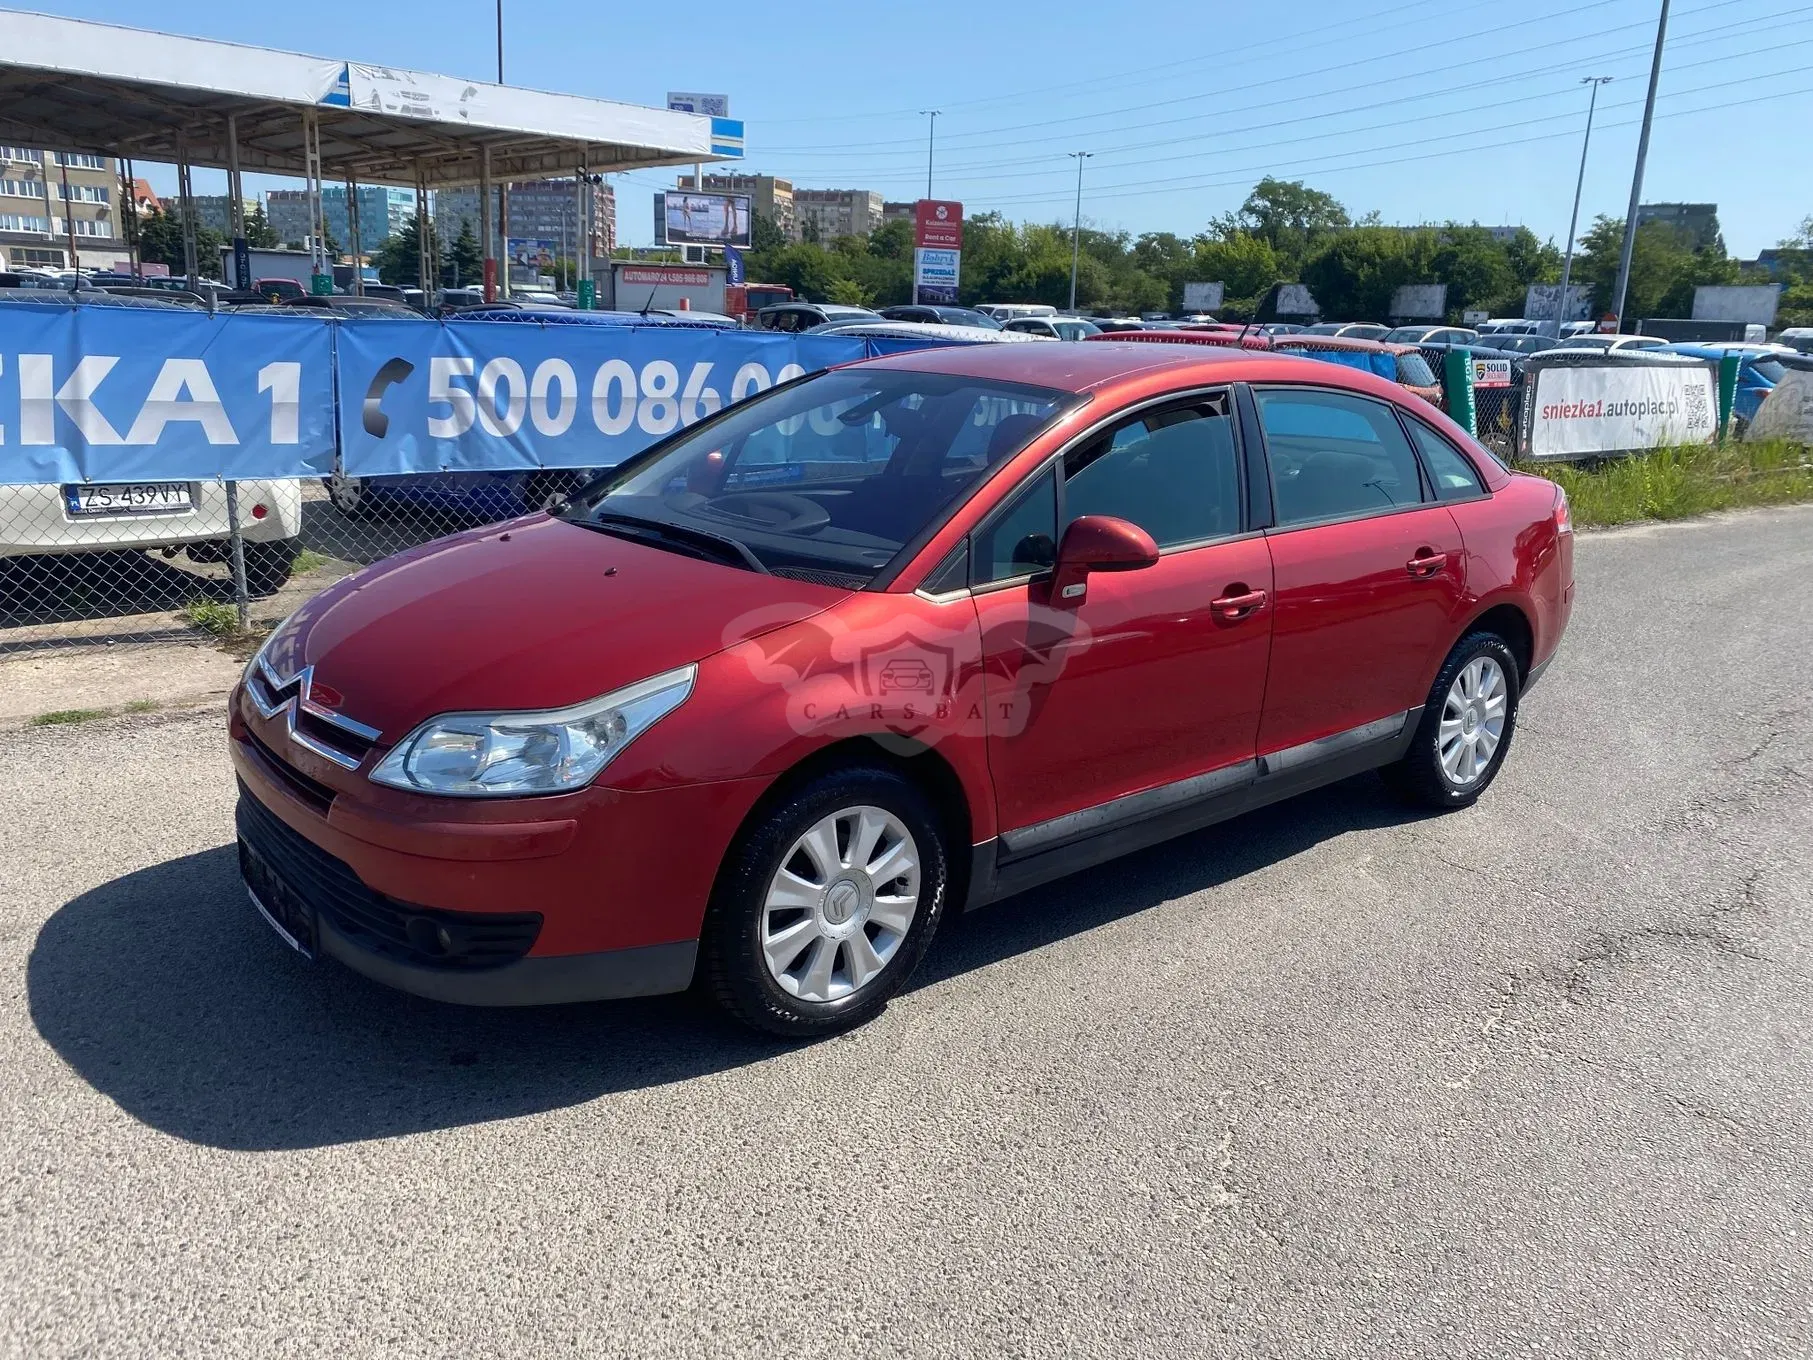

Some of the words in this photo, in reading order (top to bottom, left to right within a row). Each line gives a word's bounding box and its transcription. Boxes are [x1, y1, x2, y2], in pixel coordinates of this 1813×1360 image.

[1486, 363, 1507, 373] SOLID
[0, 354, 241, 445] KA
[258, 361, 301, 444] 1
[427, 356, 578, 439] 500
[592, 358, 721, 436] 086
[1467, 385, 1475, 409] BNP
[1542, 396, 1679, 421] sniezka1.autoplac.pl
[82, 487, 112, 507] ZS
